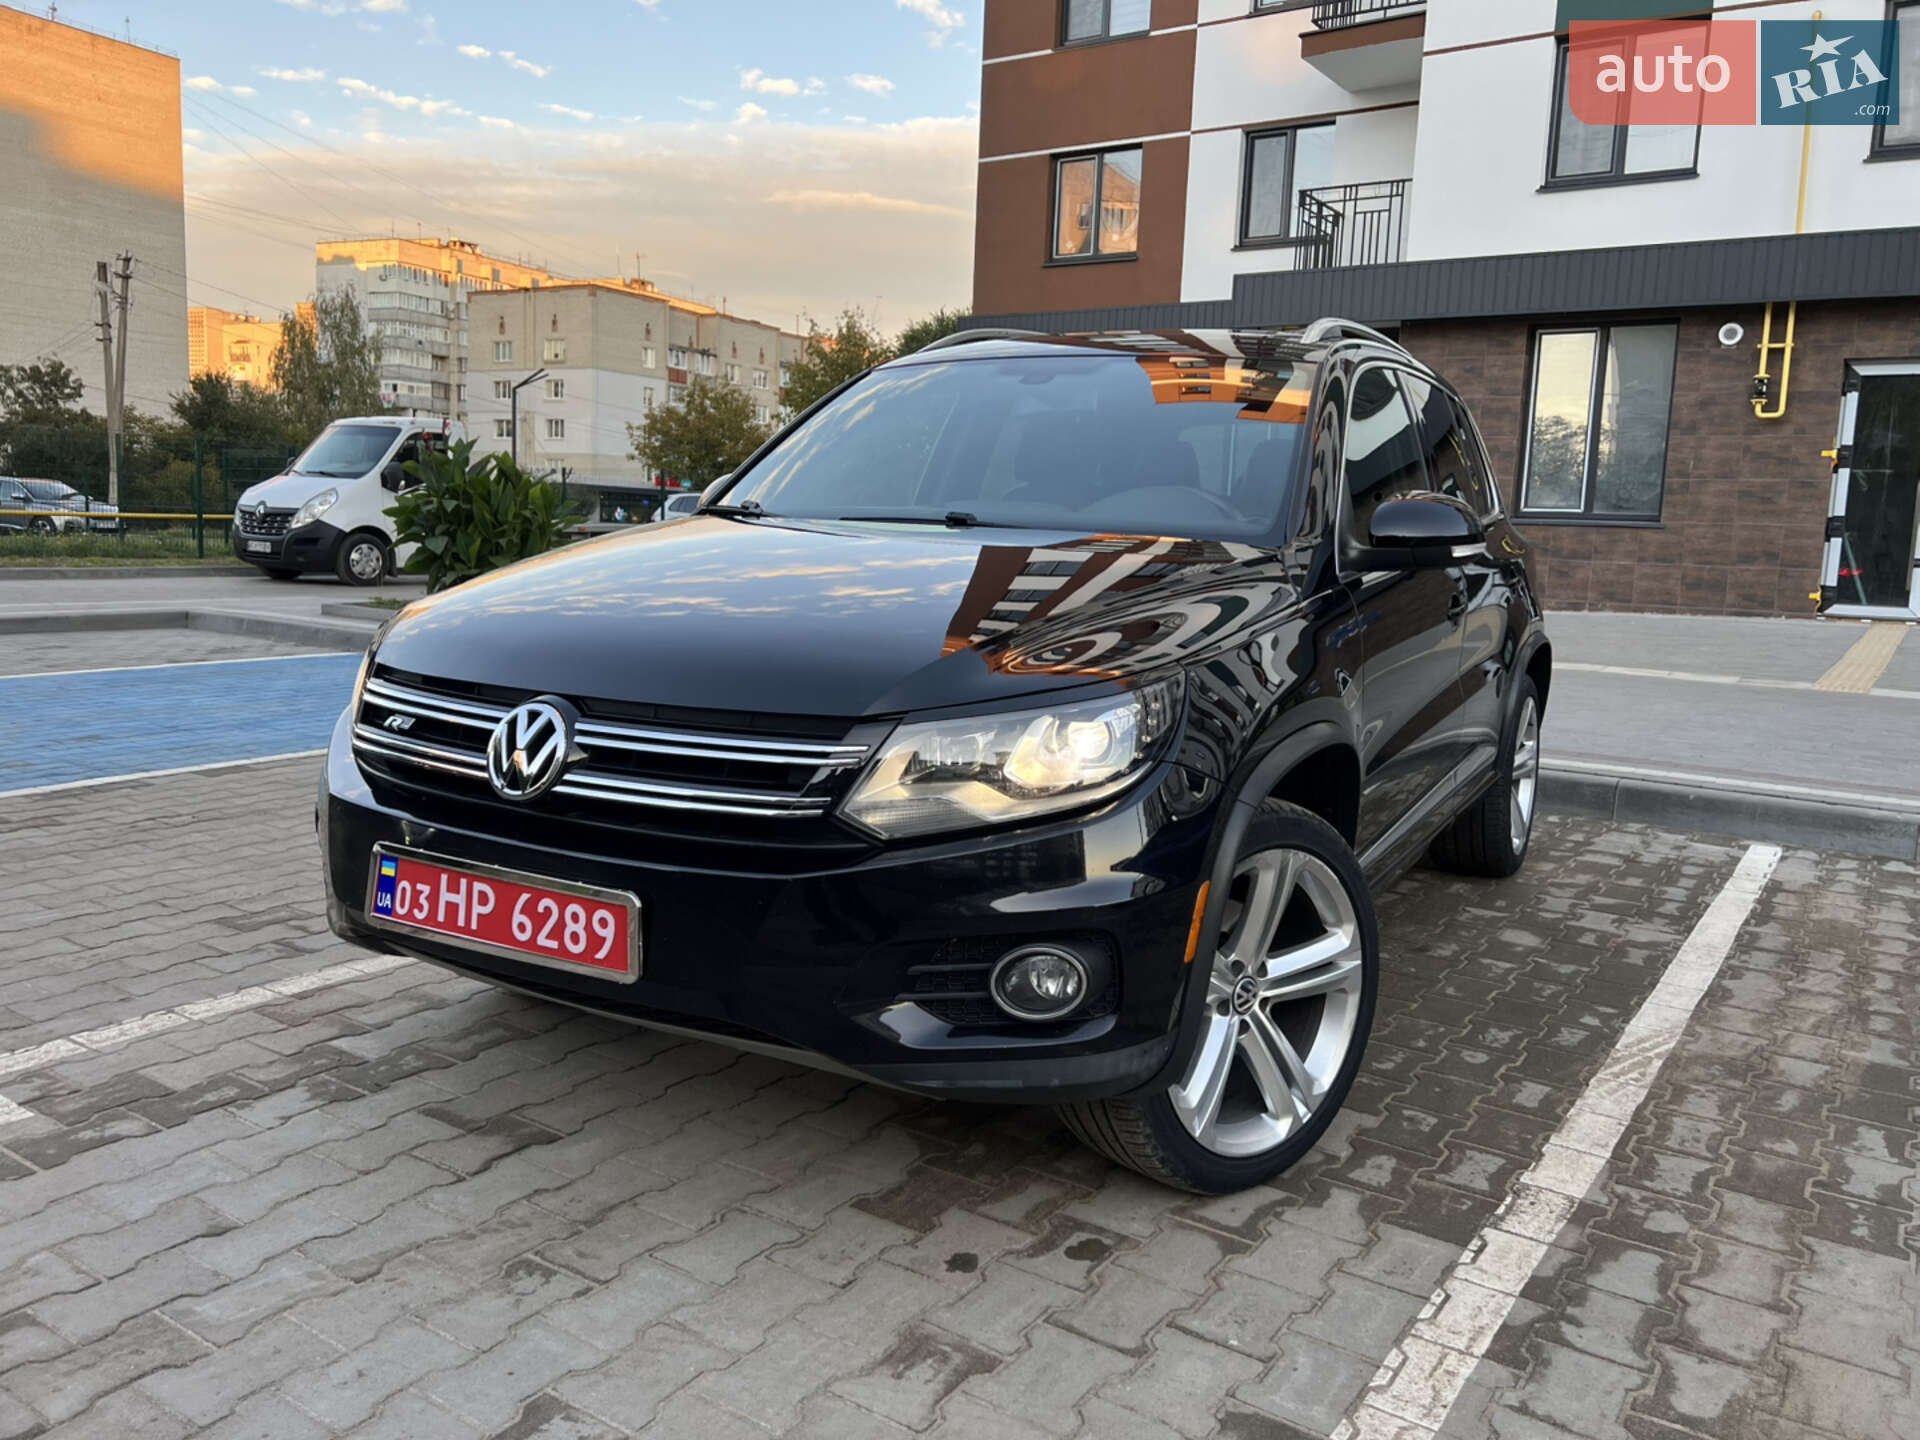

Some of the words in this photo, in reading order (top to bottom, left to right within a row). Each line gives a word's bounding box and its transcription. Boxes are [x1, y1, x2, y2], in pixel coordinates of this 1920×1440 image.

[376, 891, 392, 909] UA
[395, 880, 430, 920] 03
[437, 873, 496, 930] HP
[511, 893, 616, 960] 6289
